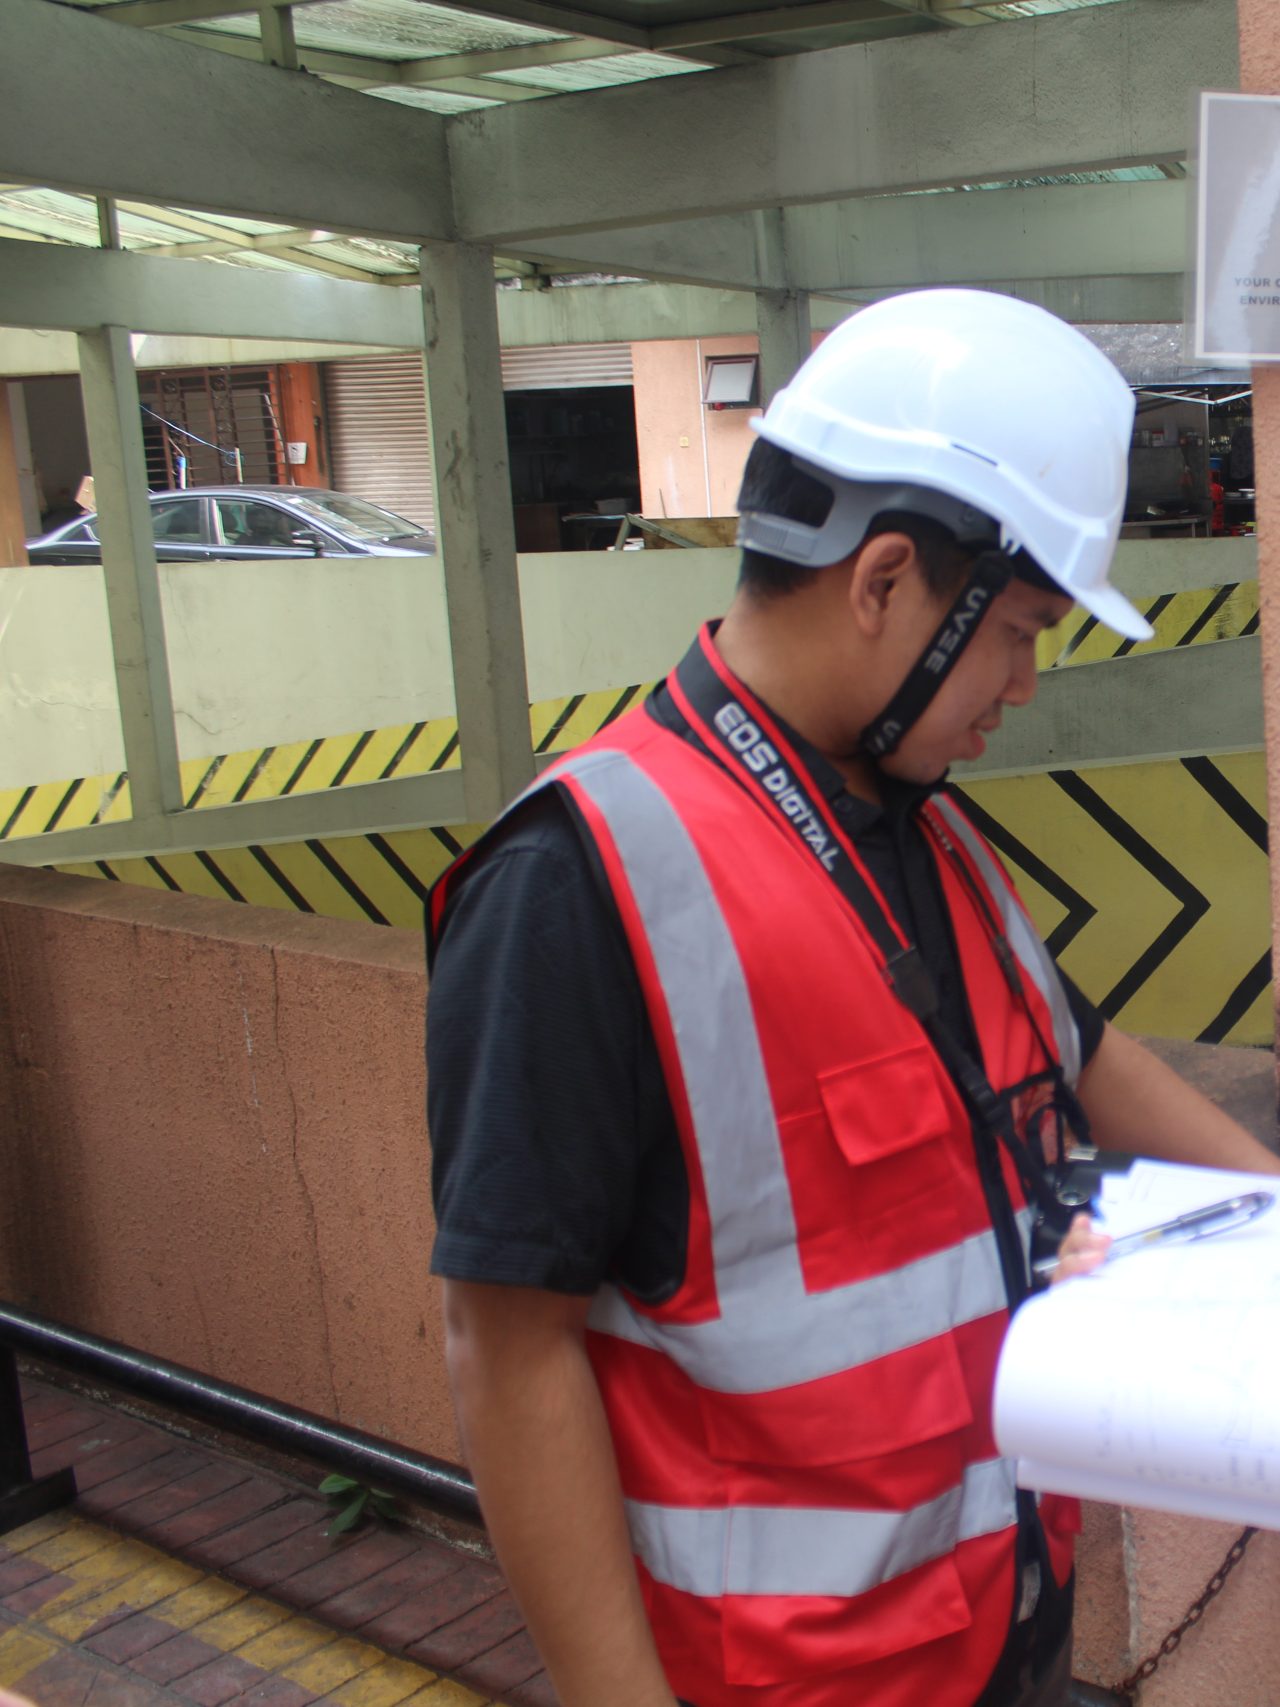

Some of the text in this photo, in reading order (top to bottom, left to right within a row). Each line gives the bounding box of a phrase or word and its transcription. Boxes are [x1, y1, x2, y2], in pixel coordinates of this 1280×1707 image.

[1234, 277, 1271, 288] YOUR
[713, 701, 840, 872] EOS DIGITAL
